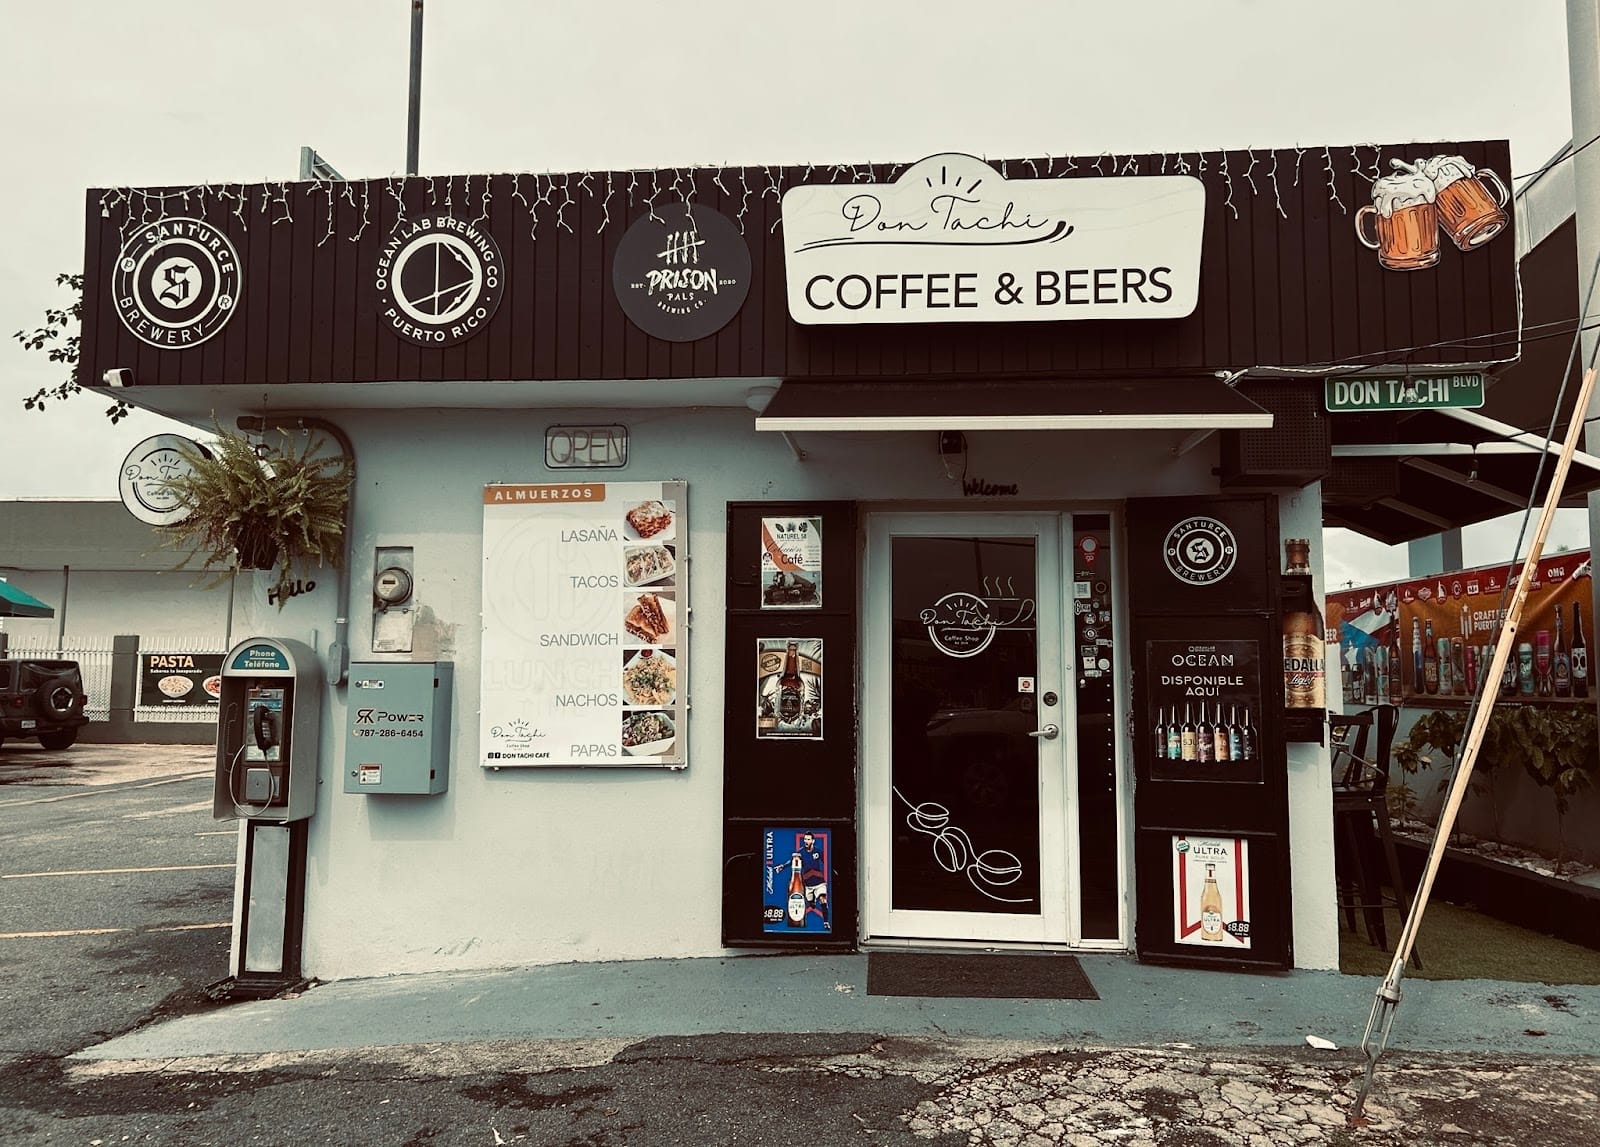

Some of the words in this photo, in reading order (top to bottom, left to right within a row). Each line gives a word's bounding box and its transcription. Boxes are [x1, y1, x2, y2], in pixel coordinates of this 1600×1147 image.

[842, 194, 928, 232] Don
[931, 195, 1048, 231] Tachi
[145, 223, 234, 274] SANTURCE
[376, 237, 402, 290] OCEAN
[401, 218, 432, 238] LAB
[436, 217, 494, 262] BREWING
[486, 266, 498, 288] CO
[646, 268, 718, 296] PRISON
[804, 272, 978, 310] COFFEE
[994, 272, 1024, 305] &
[1035, 266, 1172, 306] BEERS
[667, 292, 694, 300] PALS
[120, 296, 205, 344] BREWERY
[384, 308, 446, 342] PUERTO
[451, 307, 487, 338] RICO
[1334, 380, 1380, 405] DON
[1453, 376, 1478, 388] BLVD
[550, 430, 624, 464] OPEN
[495, 488, 592, 500] ALMUERZOS
[962, 478, 1018, 496] Welcome
[561, 526, 618, 542] LASAÑA
[1173, 521, 1227, 538] SANTURCE
[781, 554, 803, 564] Café
[1176, 564, 1226, 580] BREWERY
[570, 575, 618, 588] TACOS
[920, 608, 955, 624] Don
[956, 610, 1004, 626] Tachi
[1474, 610, 1495, 620] CRAFT
[540, 633, 618, 646] SANDWICH
[150, 656, 194, 667] PASTA
[1172, 654, 1234, 666] OCEAN
[1161, 675, 1244, 685] DISPONIBLE
[556, 694, 618, 707] NACHOS
[570, 744, 616, 757] PAPAS
[1193, 846, 1228, 855] ULTRA
